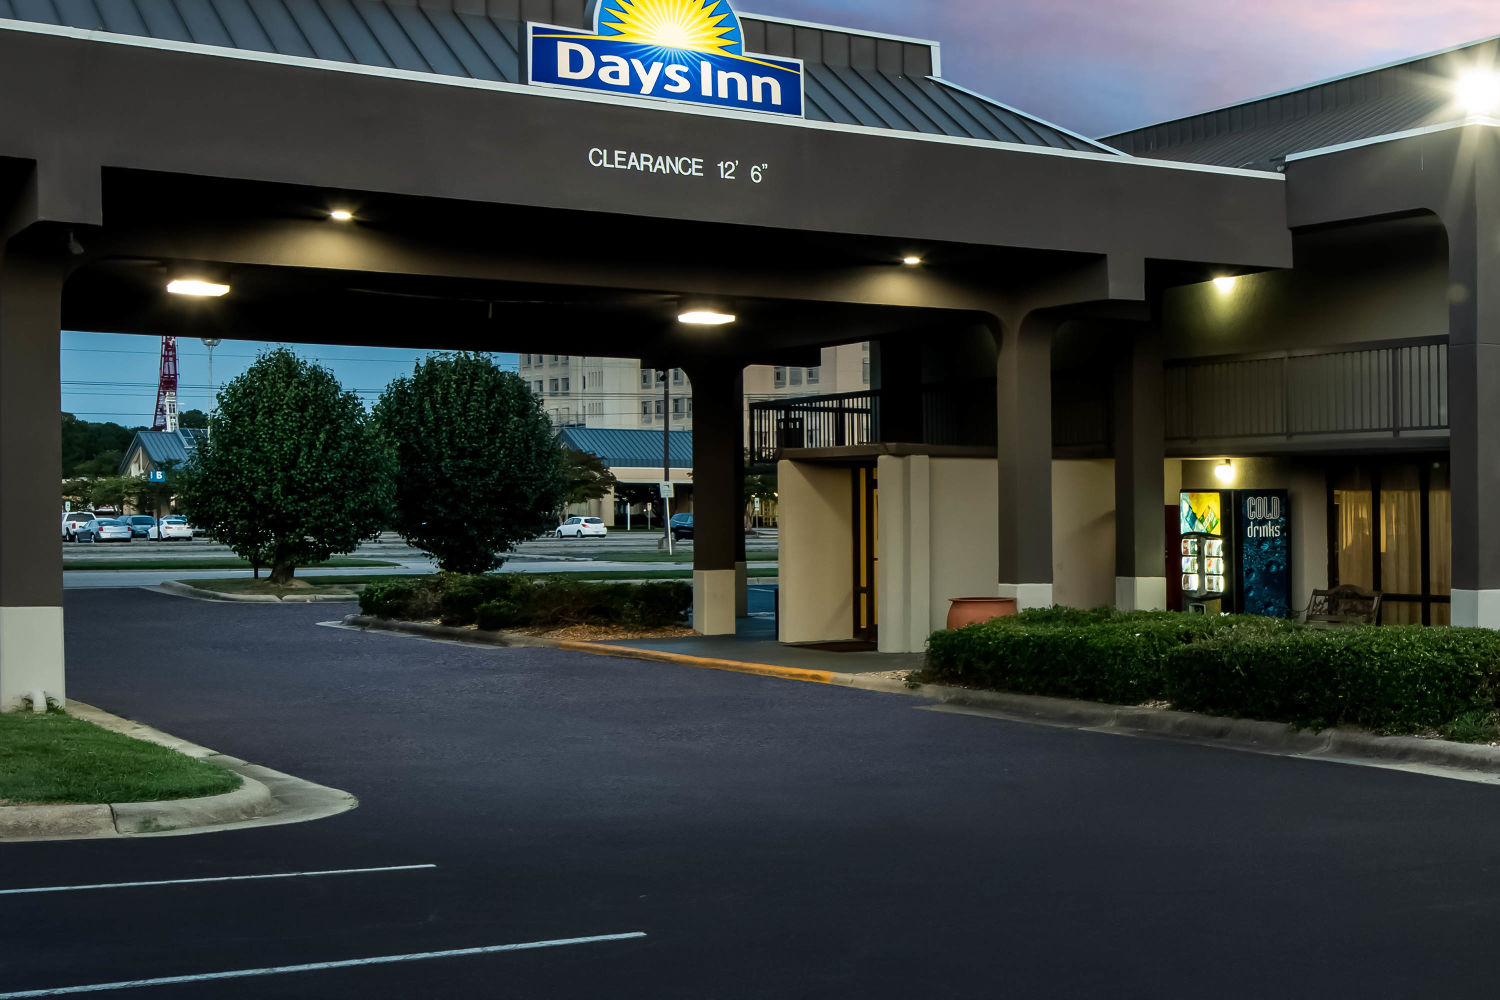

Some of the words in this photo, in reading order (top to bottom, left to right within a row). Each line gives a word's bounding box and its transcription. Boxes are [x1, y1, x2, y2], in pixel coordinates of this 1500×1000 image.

[557, 41, 691, 95] Days
[700, 60, 782, 106] Inn
[588, 148, 704, 177] CLEARANCE
[1247, 496, 1280, 520] COLD
[1247, 520, 1281, 538] drinks
